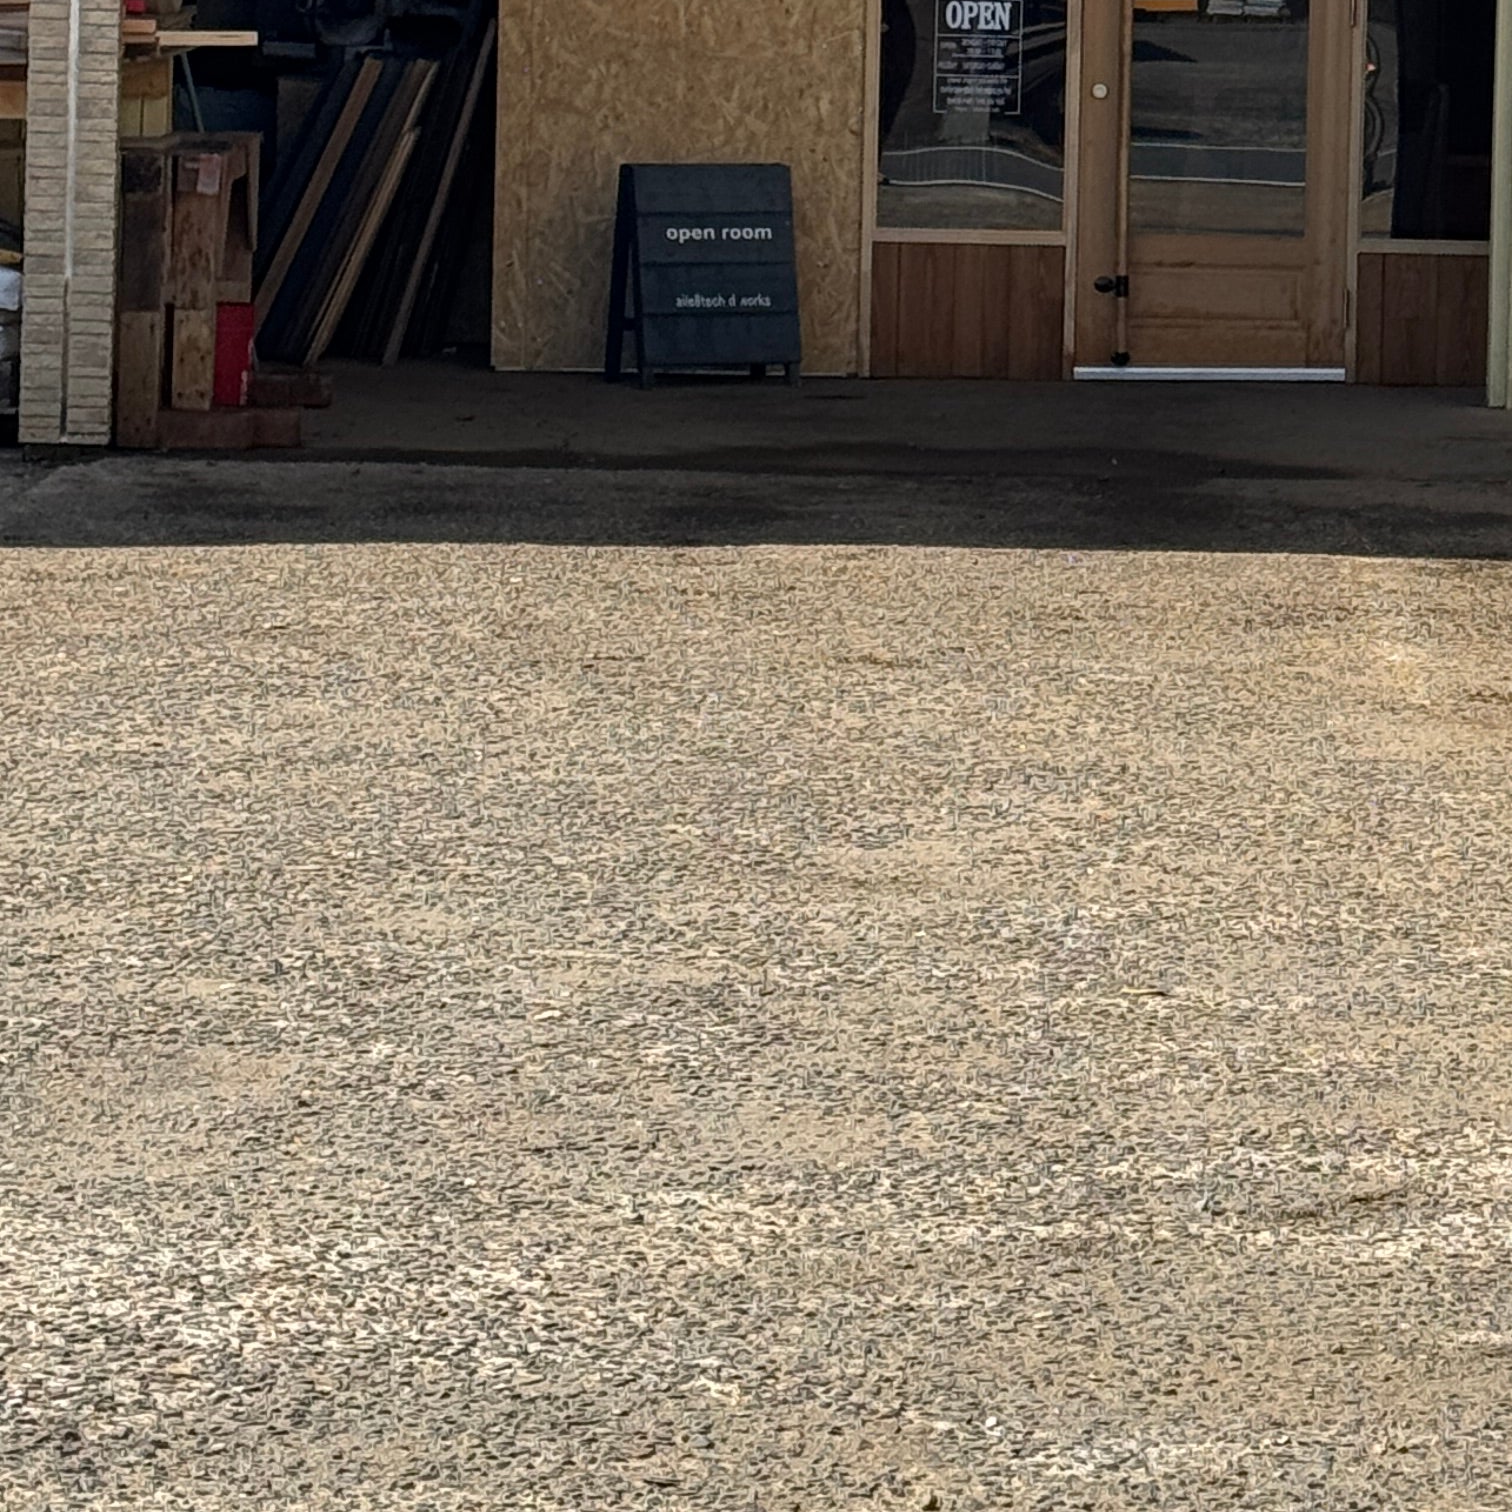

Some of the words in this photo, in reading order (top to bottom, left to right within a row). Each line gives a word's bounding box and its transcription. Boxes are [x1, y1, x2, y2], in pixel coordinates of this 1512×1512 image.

[945, 0, 1012, 31] OPEN
[666, 227, 715, 243] open
[721, 227, 772, 240] room
